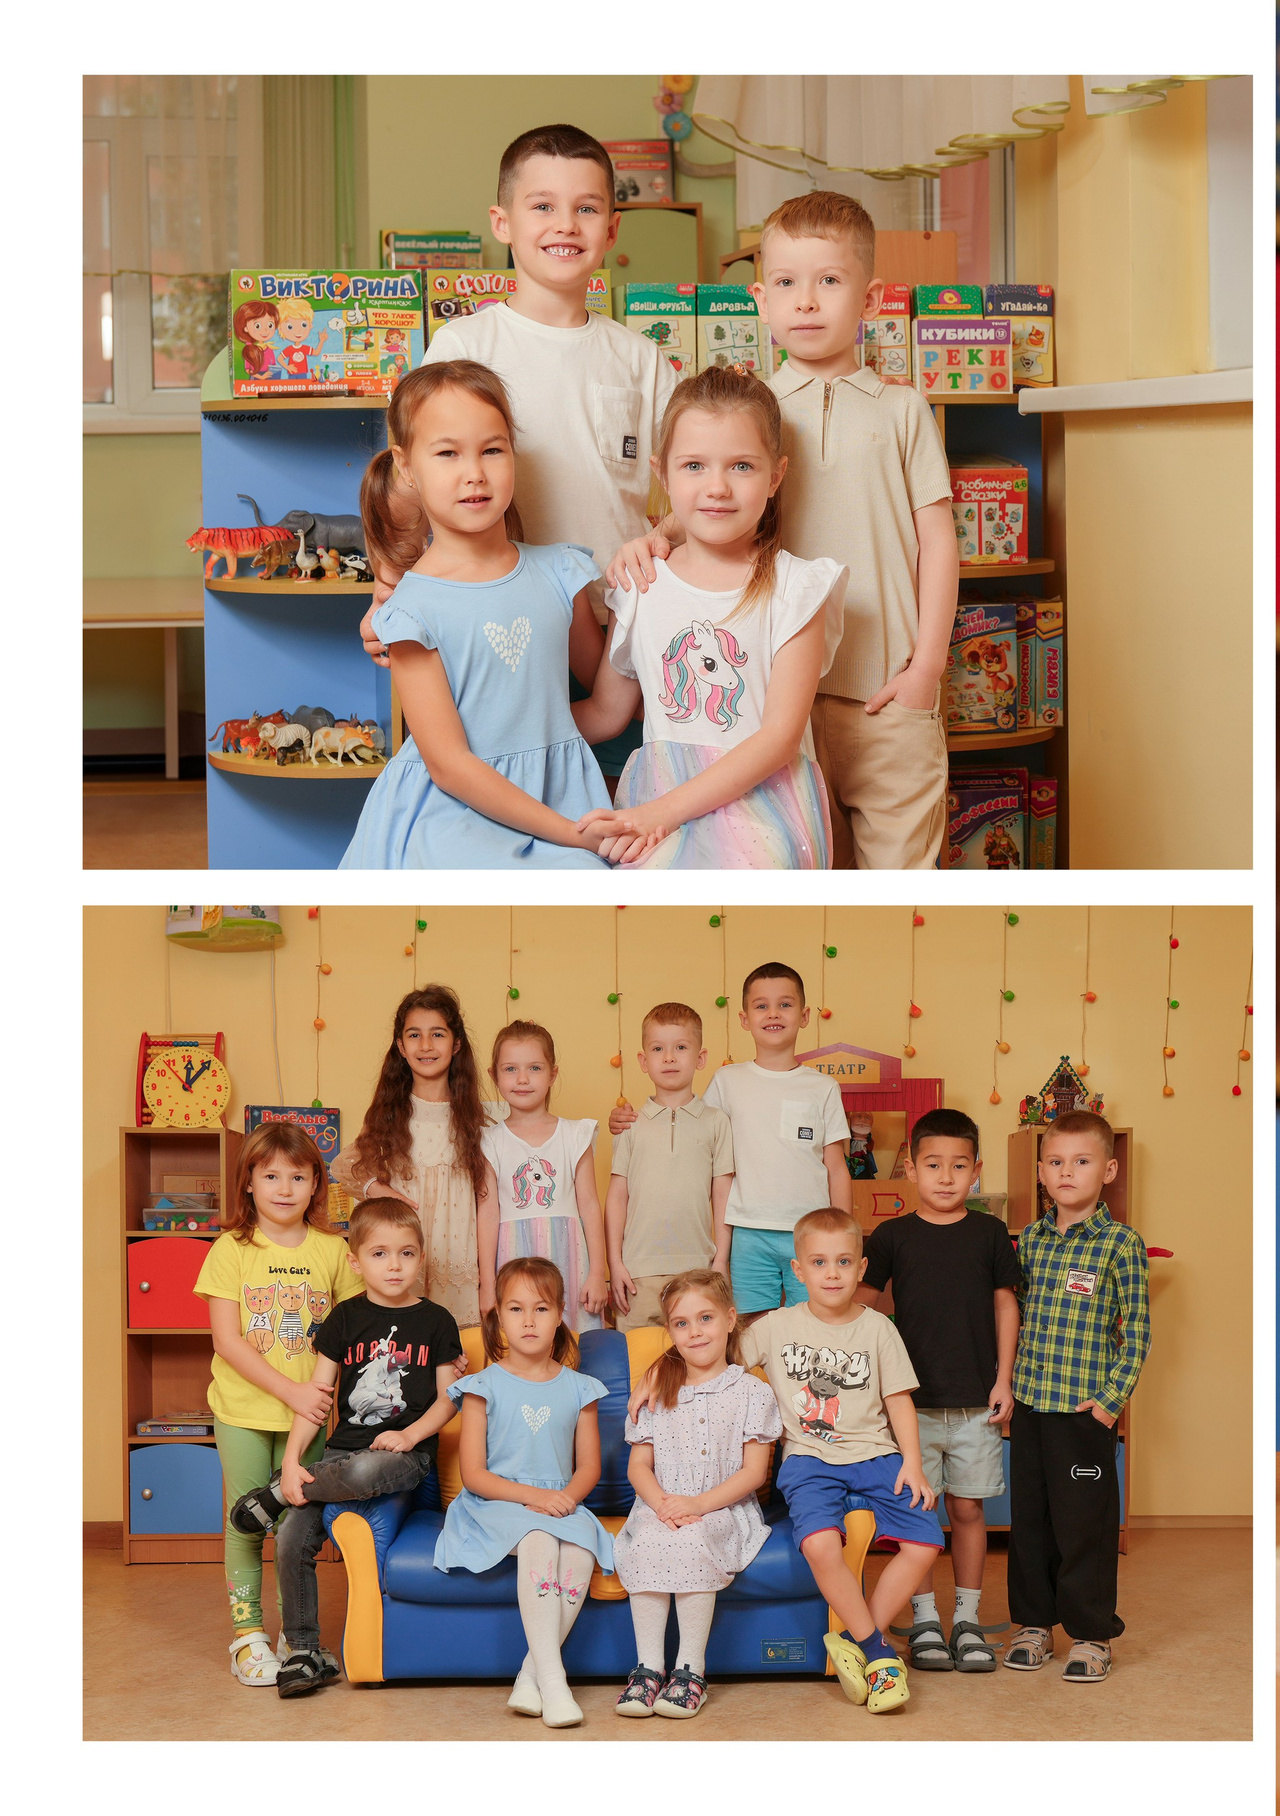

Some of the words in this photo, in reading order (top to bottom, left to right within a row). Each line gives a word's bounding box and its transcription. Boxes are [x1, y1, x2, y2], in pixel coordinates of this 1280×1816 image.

[258, 273, 420, 301] ВИКТОРИНА
[709, 302, 755, 312] ДЕРЕВЬЯ
[921, 328, 995, 341] КУБИКИ
[923, 348, 1006, 368] РЕКИ
[922, 371, 1007, 390] УТРО
[240, 384, 268, 394] Азбука
[270, 384, 306, 393] хорошего
[308, 381, 349, 391] поведения
[954, 478, 1013, 490] Любимые
[960, 489, 1007, 501] Сказки
[963, 607, 986, 625] ЧЕЙ
[953, 616, 1000, 643] ДОМИК?
[1020, 643, 1031, 707] ПРОФЕССИИ
[1046, 647, 1060, 700] БУКВЫ
[181, 1054, 192, 1062] 12
[156, 1069, 166, 1077] 10
[211, 1069, 218, 1077] 2
[816, 1063, 866, 1075] ТЕАТР
[151, 1083, 157, 1091] 9
[156, 1098, 162, 1106] 8
[211, 1099, 218, 1107] 4
[168, 1109, 174, 1117] 7
[184, 1113, 190, 1121] 6
[200, 1109, 206, 1117] 5
[261, 1109, 328, 1124] Весёлые
[268, 1265, 287, 1274] Love
[289, 1265, 311, 1275] Cat's
[252, 1316, 267, 1328] 23
[343, 1340, 430, 1367] JORDAN
